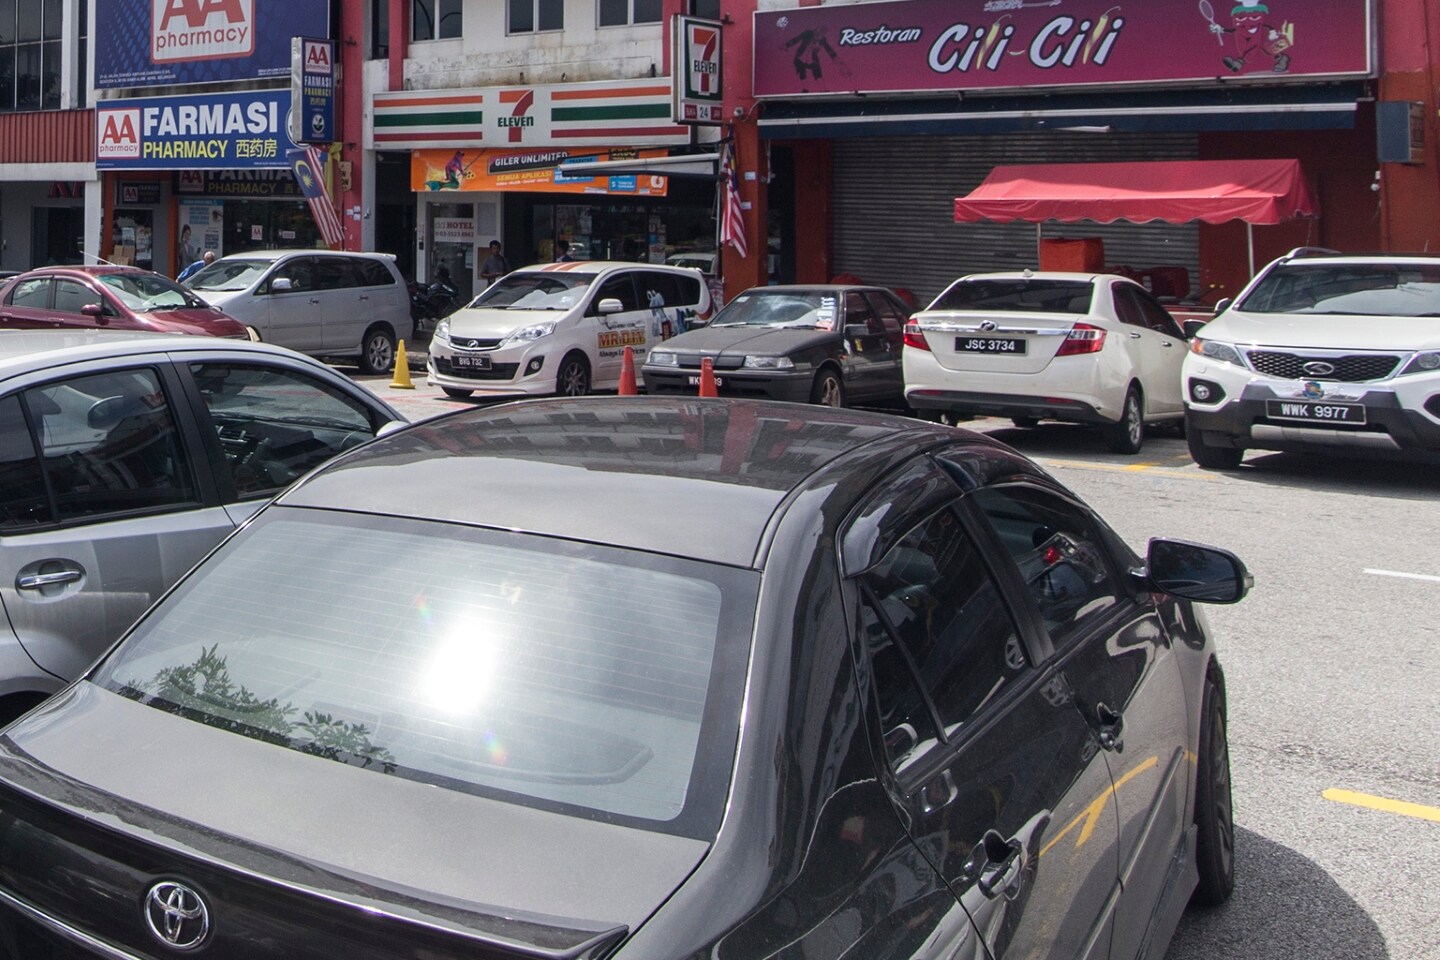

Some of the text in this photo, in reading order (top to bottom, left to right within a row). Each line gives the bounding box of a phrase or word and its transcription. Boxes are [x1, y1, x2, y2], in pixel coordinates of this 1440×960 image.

[156, 26, 248, 51] pharmacy
[840, 26, 923, 46] Restoran
[307, 45, 329, 65] AA
[693, 28, 716, 92] 7
[304, 76, 332, 87] FARMASI
[143, 102, 278, 136] FARMASI
[499, 90, 533, 142] 7
[700, 106, 709, 118] 24
[101, 114, 137, 144] AA
[100, 144, 139, 153] pharmacy
[143, 140, 228, 158] PHARMACY
[235, 138, 278, 158] 西药房
[495, 156, 519, 167] GILER
[209, 183, 276, 195] PHARMACY
[600, 349, 618, 357] Always
[965, 339, 1015, 351] JSC 3734
[471, 358, 483, 366] 732
[1281, 403, 1349, 419] WWK 9977
